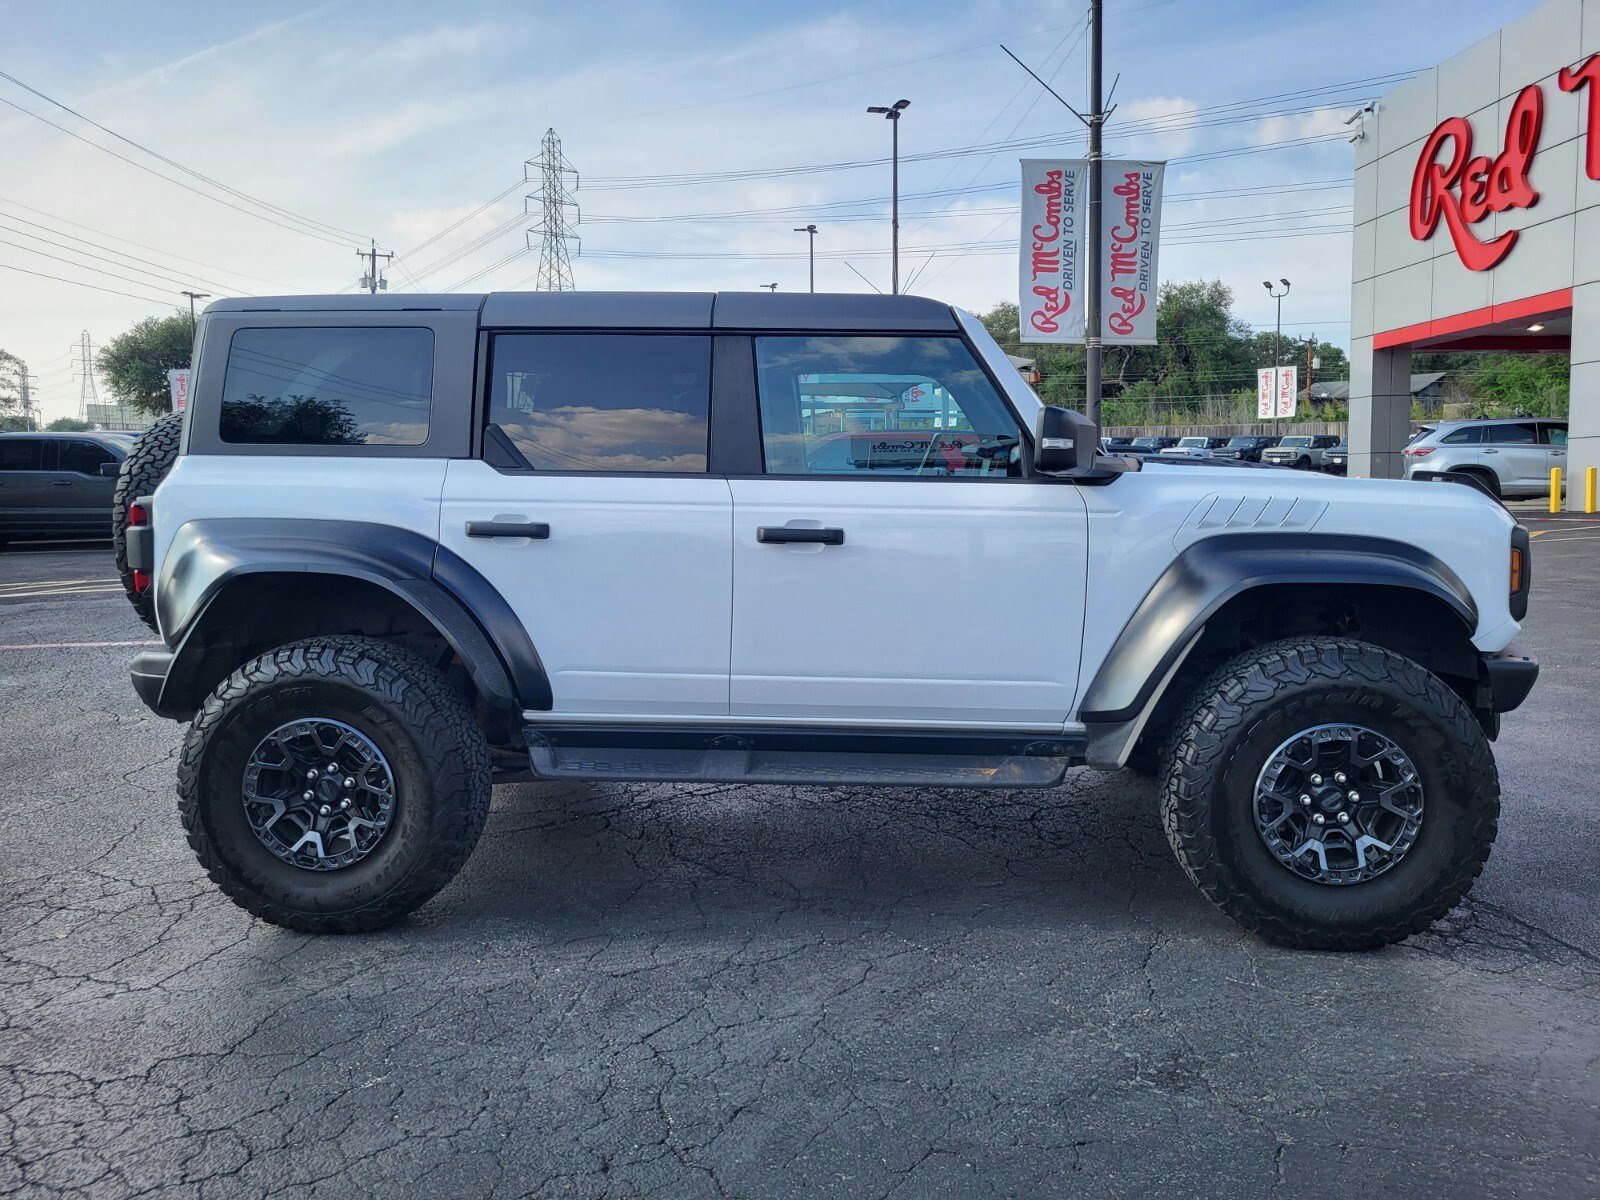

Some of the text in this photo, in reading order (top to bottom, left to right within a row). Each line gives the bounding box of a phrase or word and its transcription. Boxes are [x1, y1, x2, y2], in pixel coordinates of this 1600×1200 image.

[1031, 169, 1071, 333] Red McCombs
[1062, 169, 1075, 291] DRIVEN TO SERVE
[1108, 172, 1146, 336] Red McCombs
[1138, 172, 1153, 292] DRIVEN TO SERVE
[1409, 84, 1544, 272] Red
